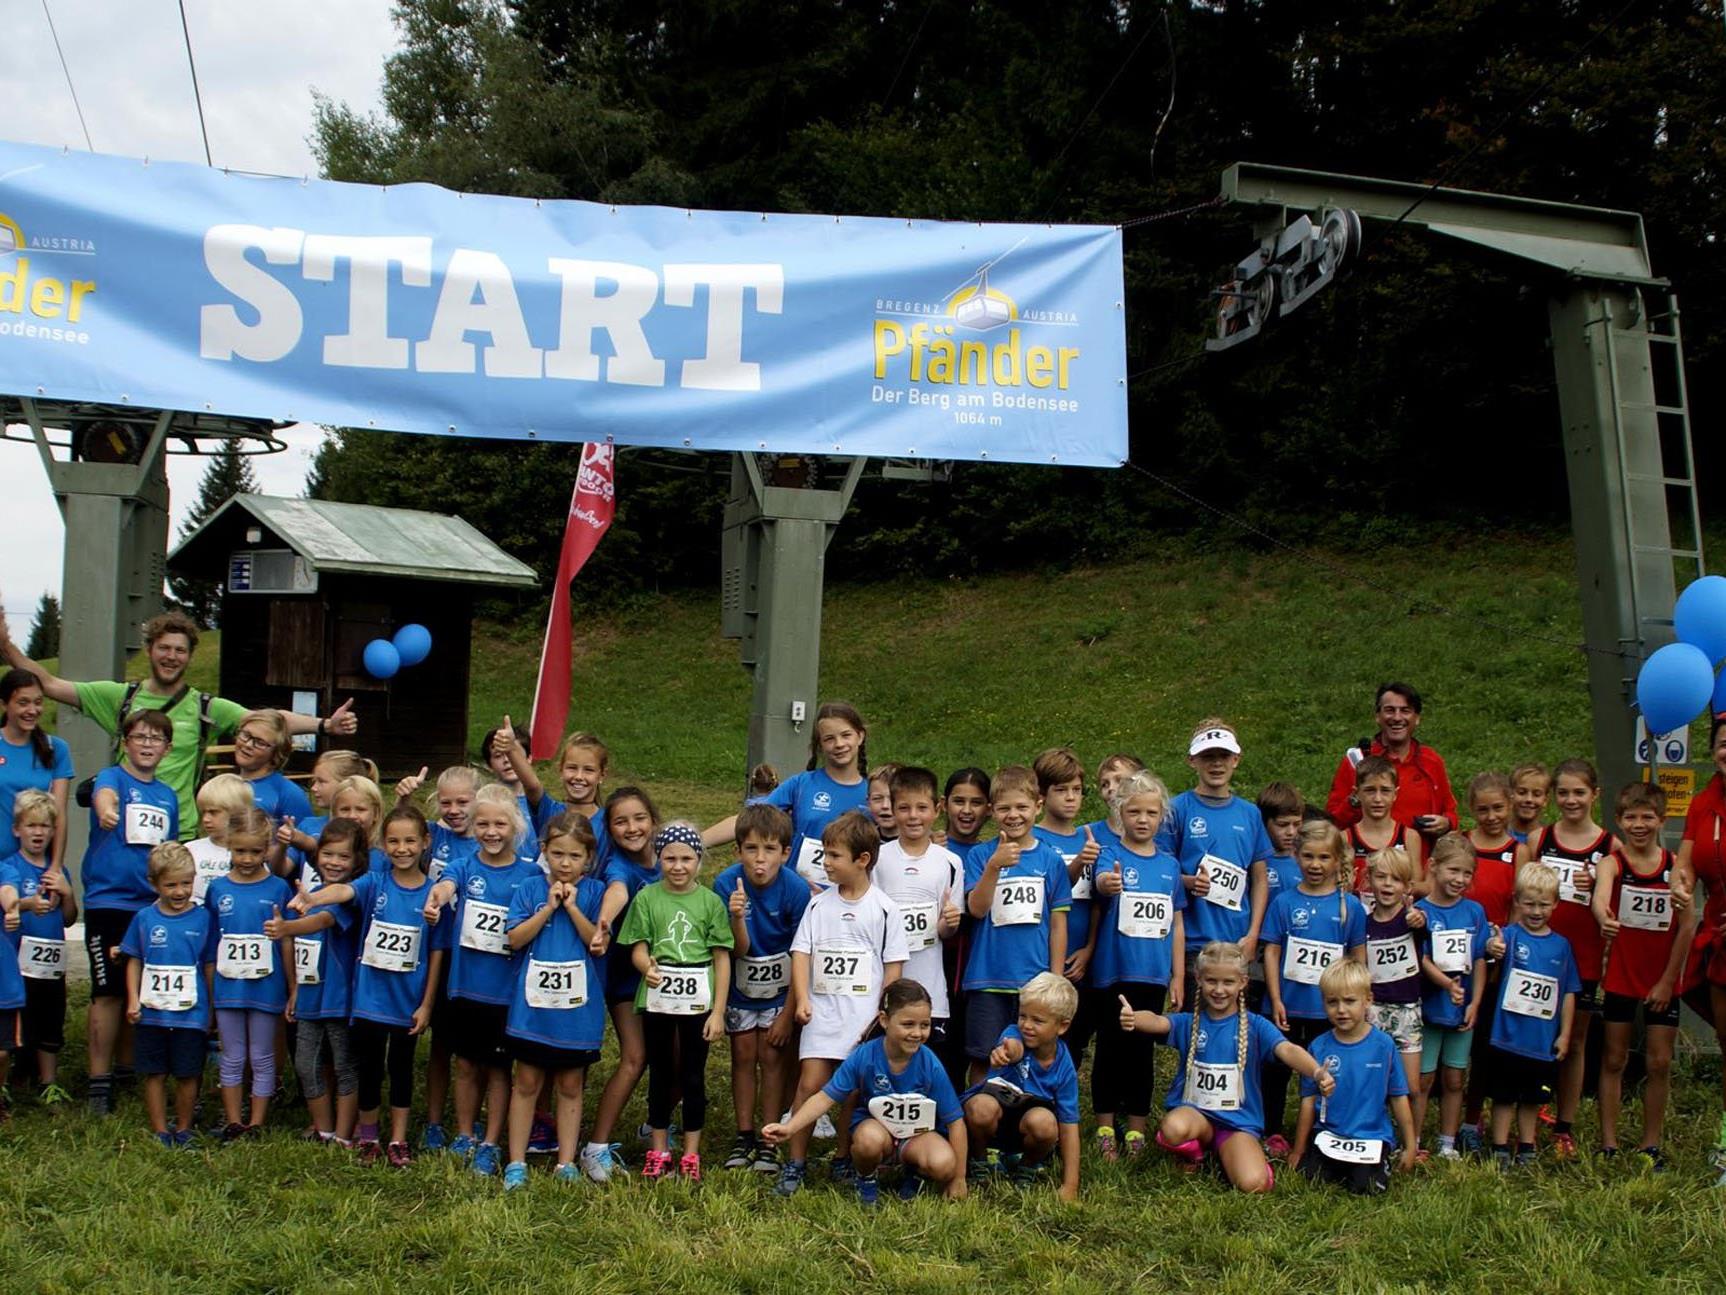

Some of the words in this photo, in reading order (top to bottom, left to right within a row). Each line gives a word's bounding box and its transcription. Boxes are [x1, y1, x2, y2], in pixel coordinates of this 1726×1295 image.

[31, 236, 96, 251] AUSTRIA
[0, 256, 97, 324] der
[201, 224, 784, 391] START
[876, 299, 942, 314] BREGENZ
[1023, 310, 1078, 323] AUSTRIA
[874, 319, 1080, 390] Pfänder
[872, 385, 904, 403] Der
[908, 387, 951, 409] Berg
[956, 393, 986, 407] am
[992, 391, 1079, 412] Bodensee
[954, 411, 985, 425] 1064
[989, 414, 1002, 425] m
[139, 813, 164, 830] 244
[1210, 868, 1239, 891] 250
[1001, 886, 1037, 905] 248
[1632, 895, 1665, 914] 218
[1133, 901, 1165, 920] 206
[376, 931, 411, 952] 223
[31, 946, 60, 963] 226
[227, 943, 261, 960] 213
[1297, 948, 1331, 968] 216
[1376, 945, 1409, 965] 252
[747, 963, 782, 982] 228
[823, 956, 859, 975] 237
[152, 975, 184, 992] 214
[539, 971, 572, 990] 231
[660, 976, 697, 995] 238
[1519, 980, 1551, 1001] 230
[1196, 1071, 1228, 1091] 204
[882, 1101, 921, 1121] 215
[1330, 1139, 1367, 1153] 205
